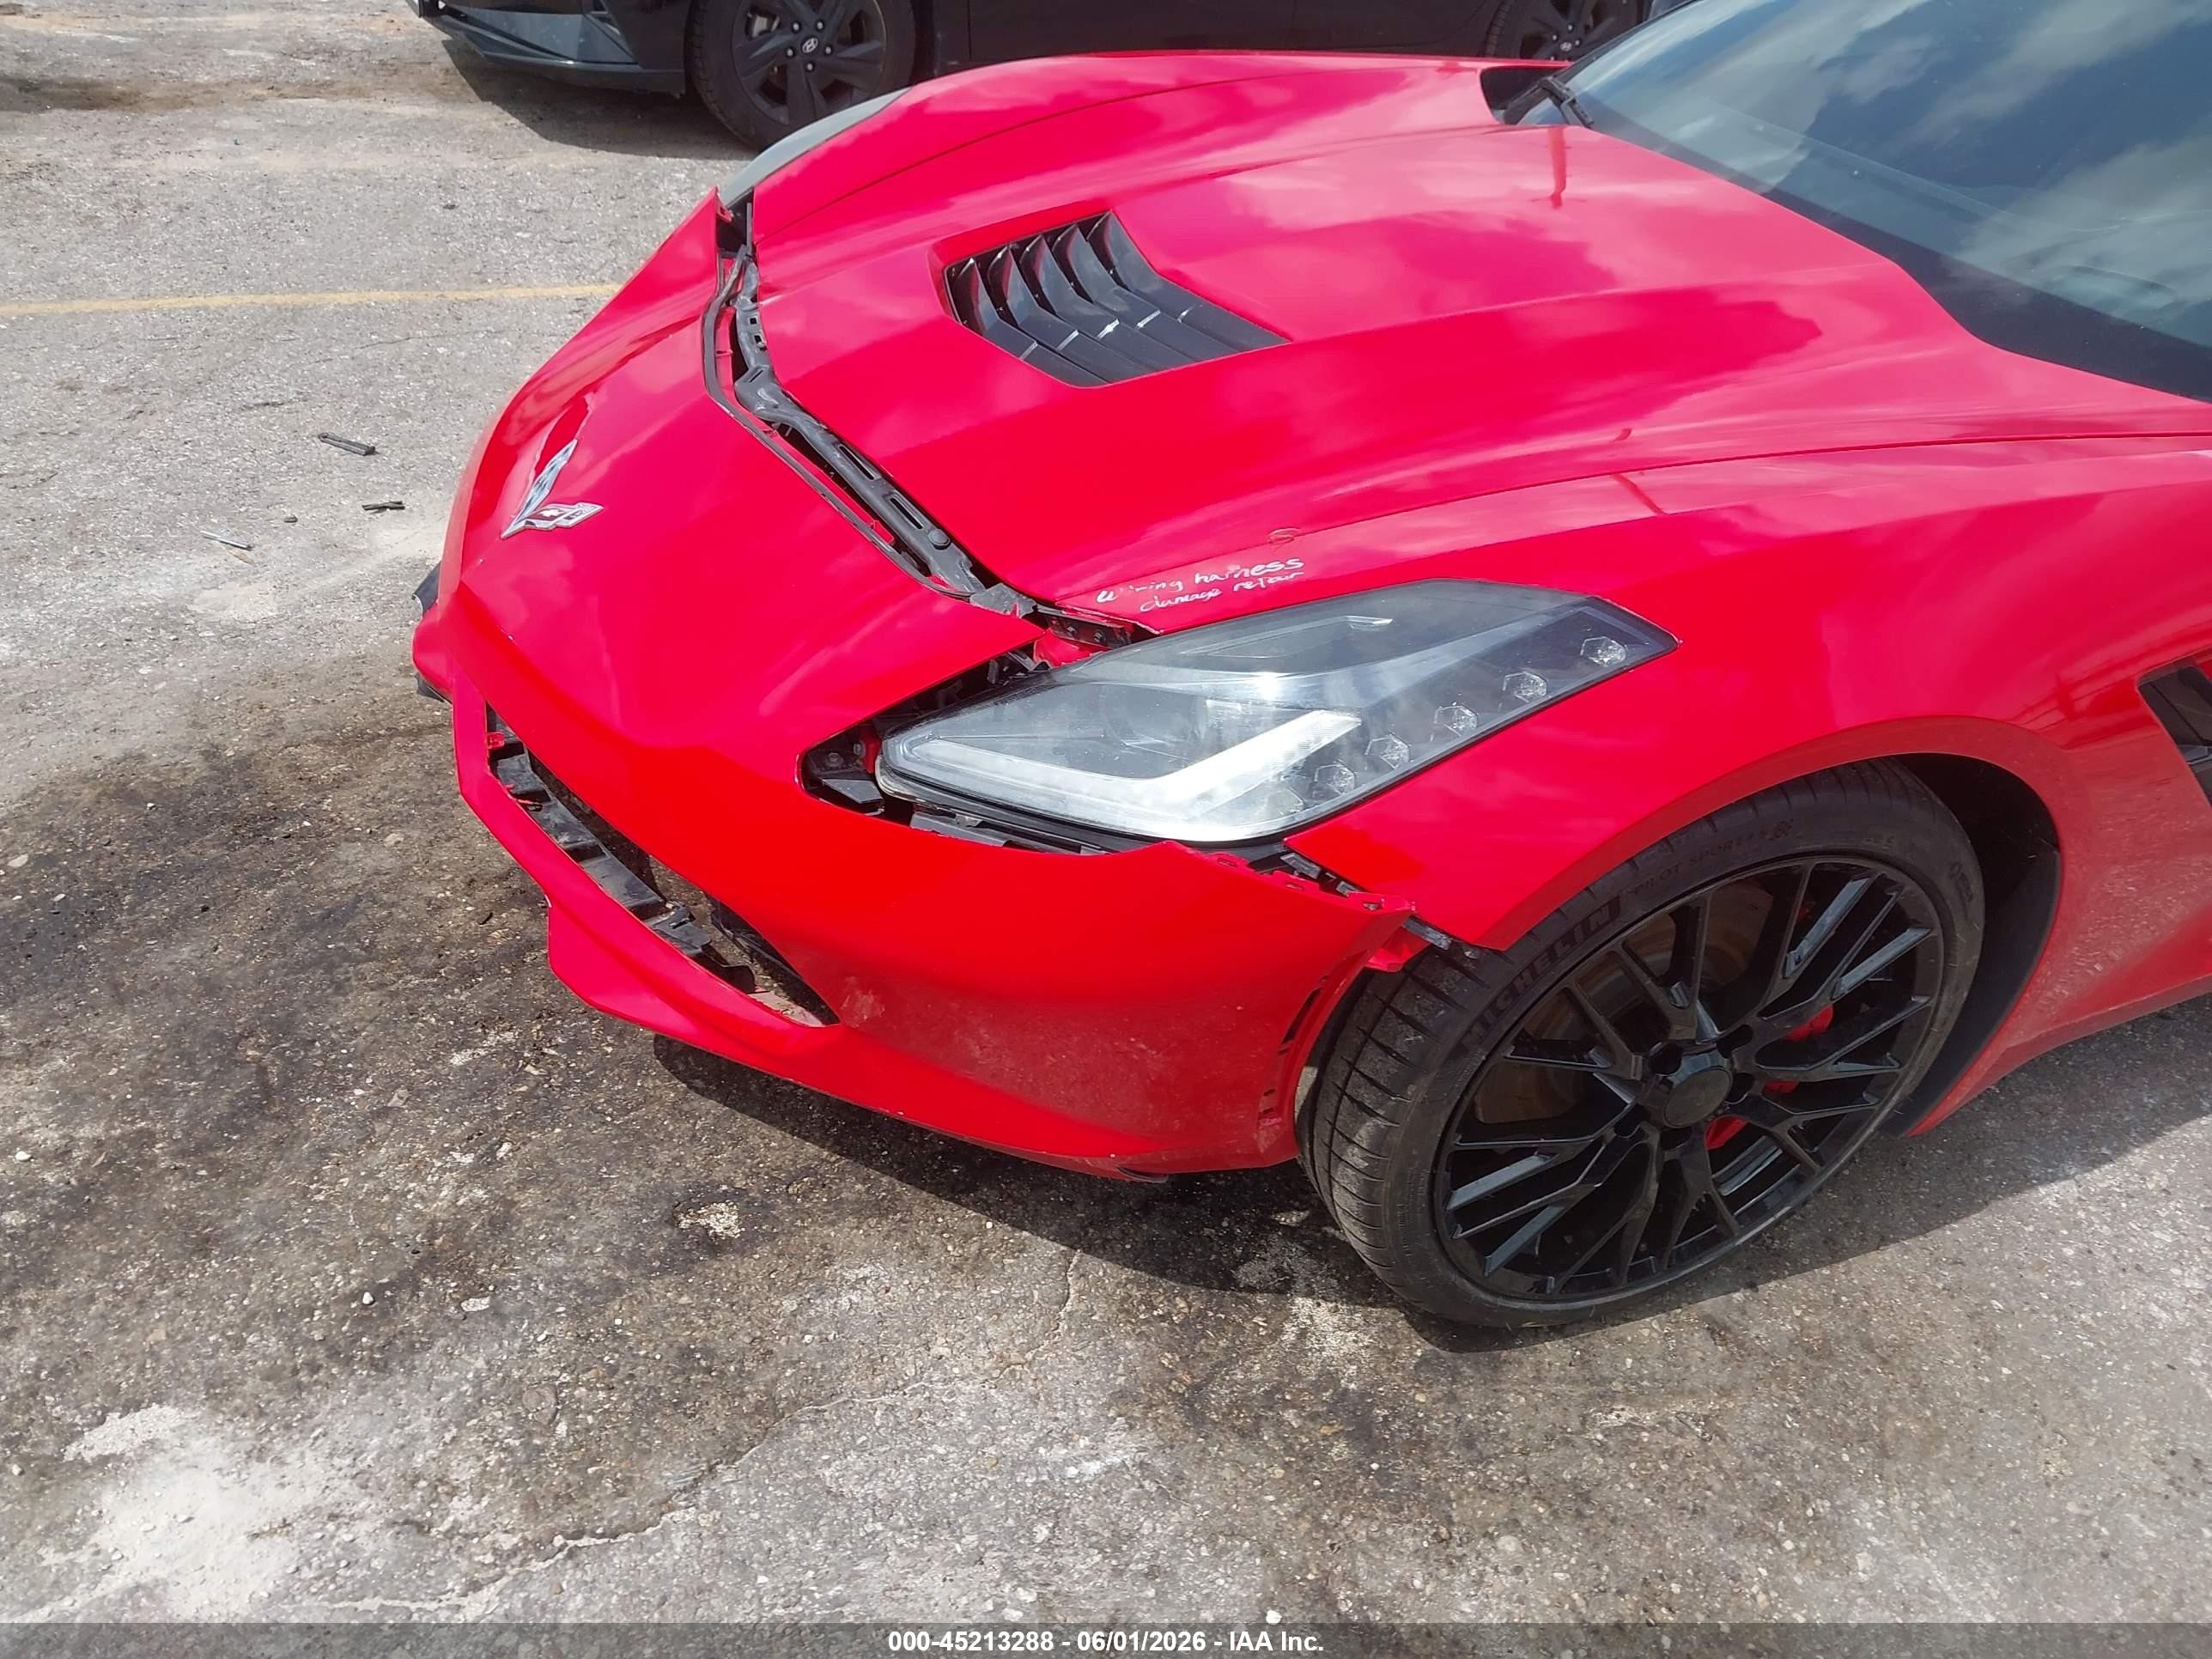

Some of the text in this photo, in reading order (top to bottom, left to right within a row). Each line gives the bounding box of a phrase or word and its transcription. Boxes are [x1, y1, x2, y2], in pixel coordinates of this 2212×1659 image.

[1194, 557, 1304, 585] harness
[1139, 587, 1223, 612] damage
[1462, 899, 1616, 1049] MICHELIN
